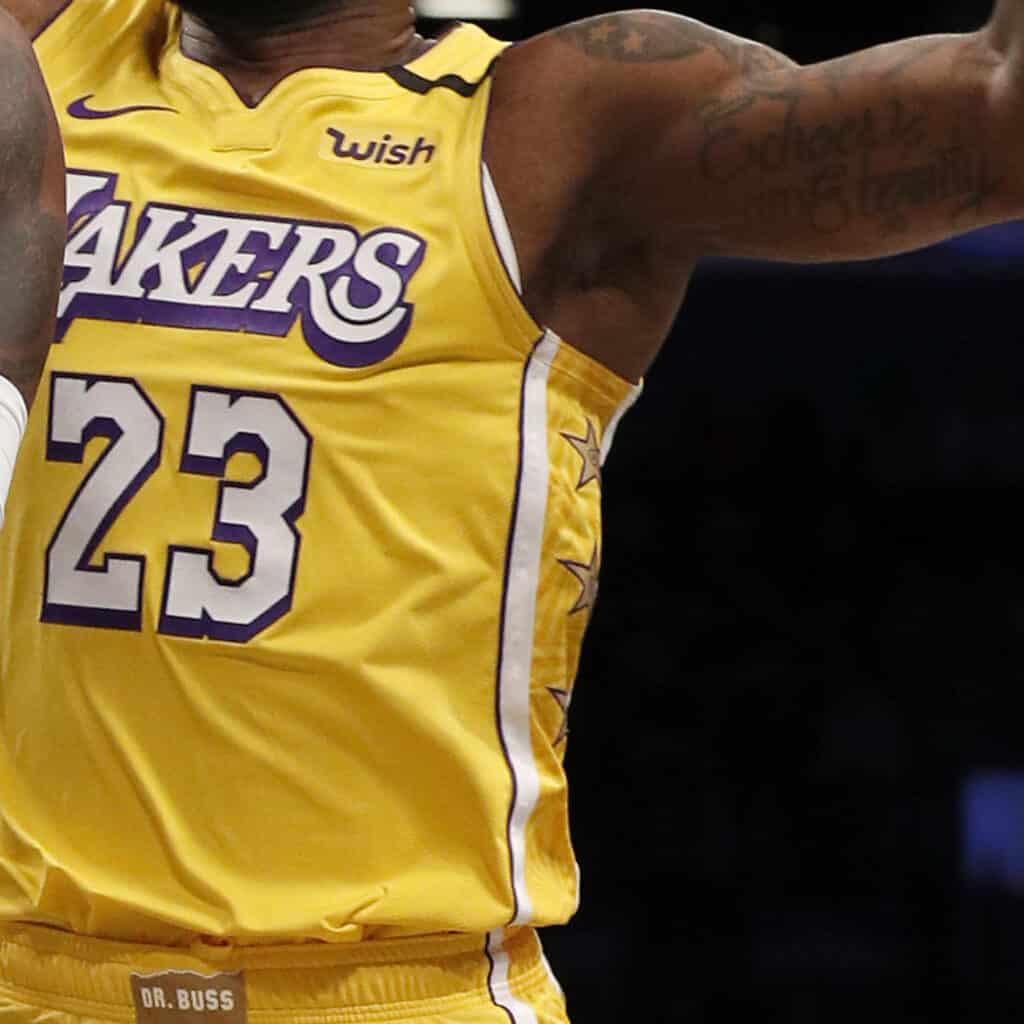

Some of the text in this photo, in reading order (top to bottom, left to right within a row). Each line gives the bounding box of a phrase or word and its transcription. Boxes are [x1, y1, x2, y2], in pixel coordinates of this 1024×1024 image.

[325, 126, 435, 166] wish
[40, 370, 313, 644] 23
[140, 986, 235, 1012] DR. BUSS
